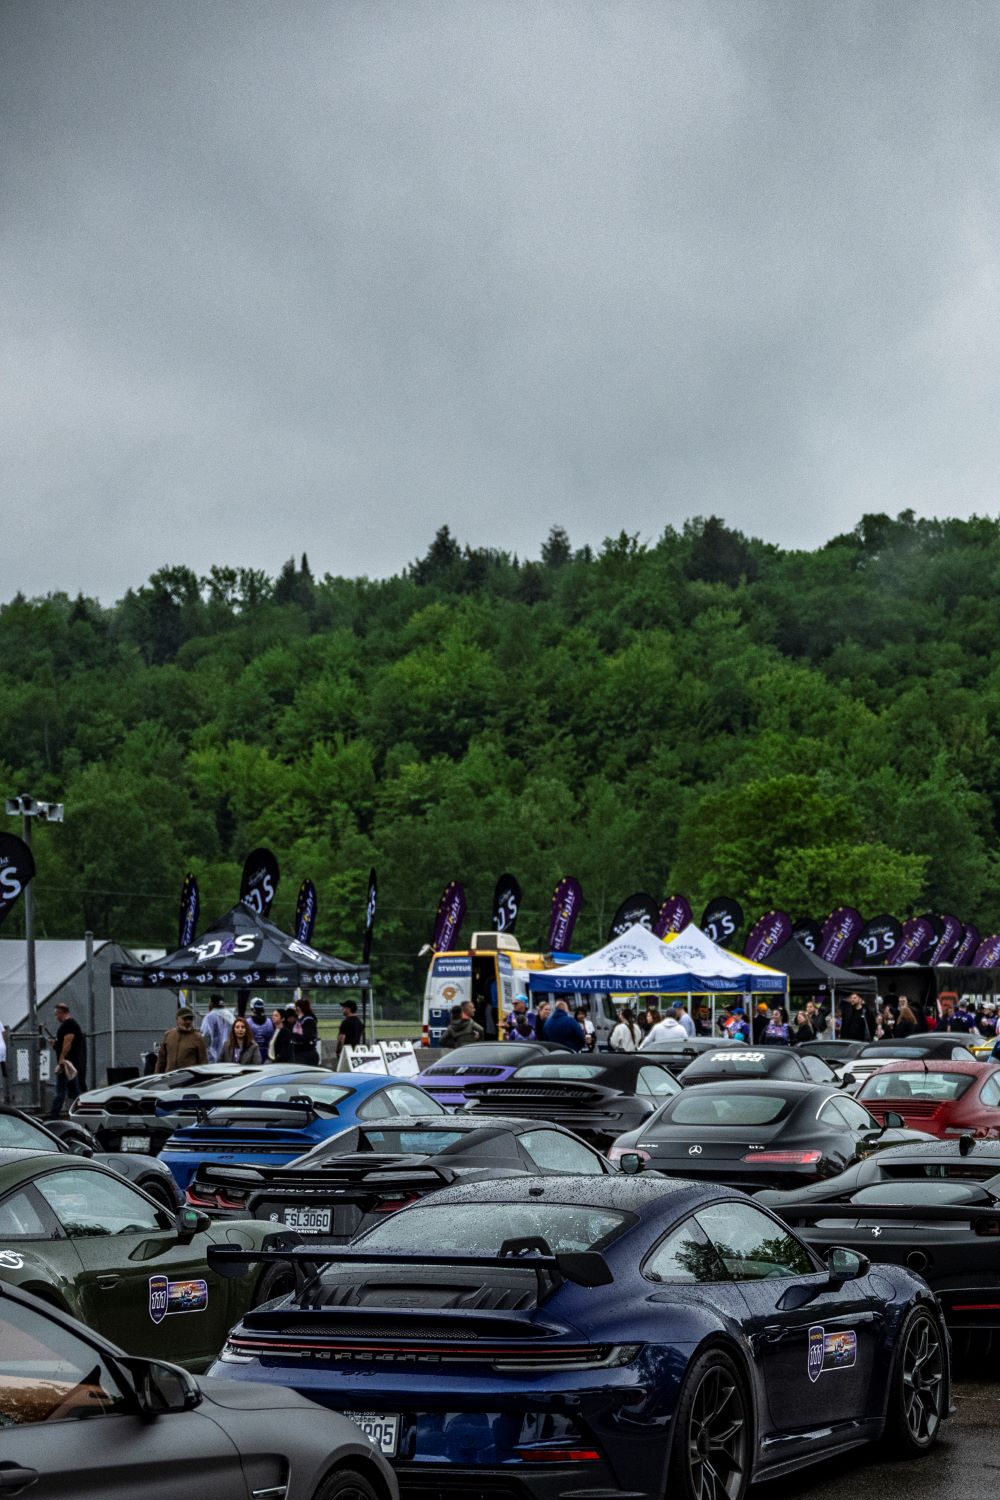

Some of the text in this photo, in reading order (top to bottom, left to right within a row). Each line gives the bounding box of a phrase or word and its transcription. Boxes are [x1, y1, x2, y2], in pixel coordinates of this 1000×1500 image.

[555, 978, 662, 990] ST-VIATEUR BAGEL
[284, 1213, 329, 1227] FSL3060
[300, 1350, 440, 1363] PORSCHE
